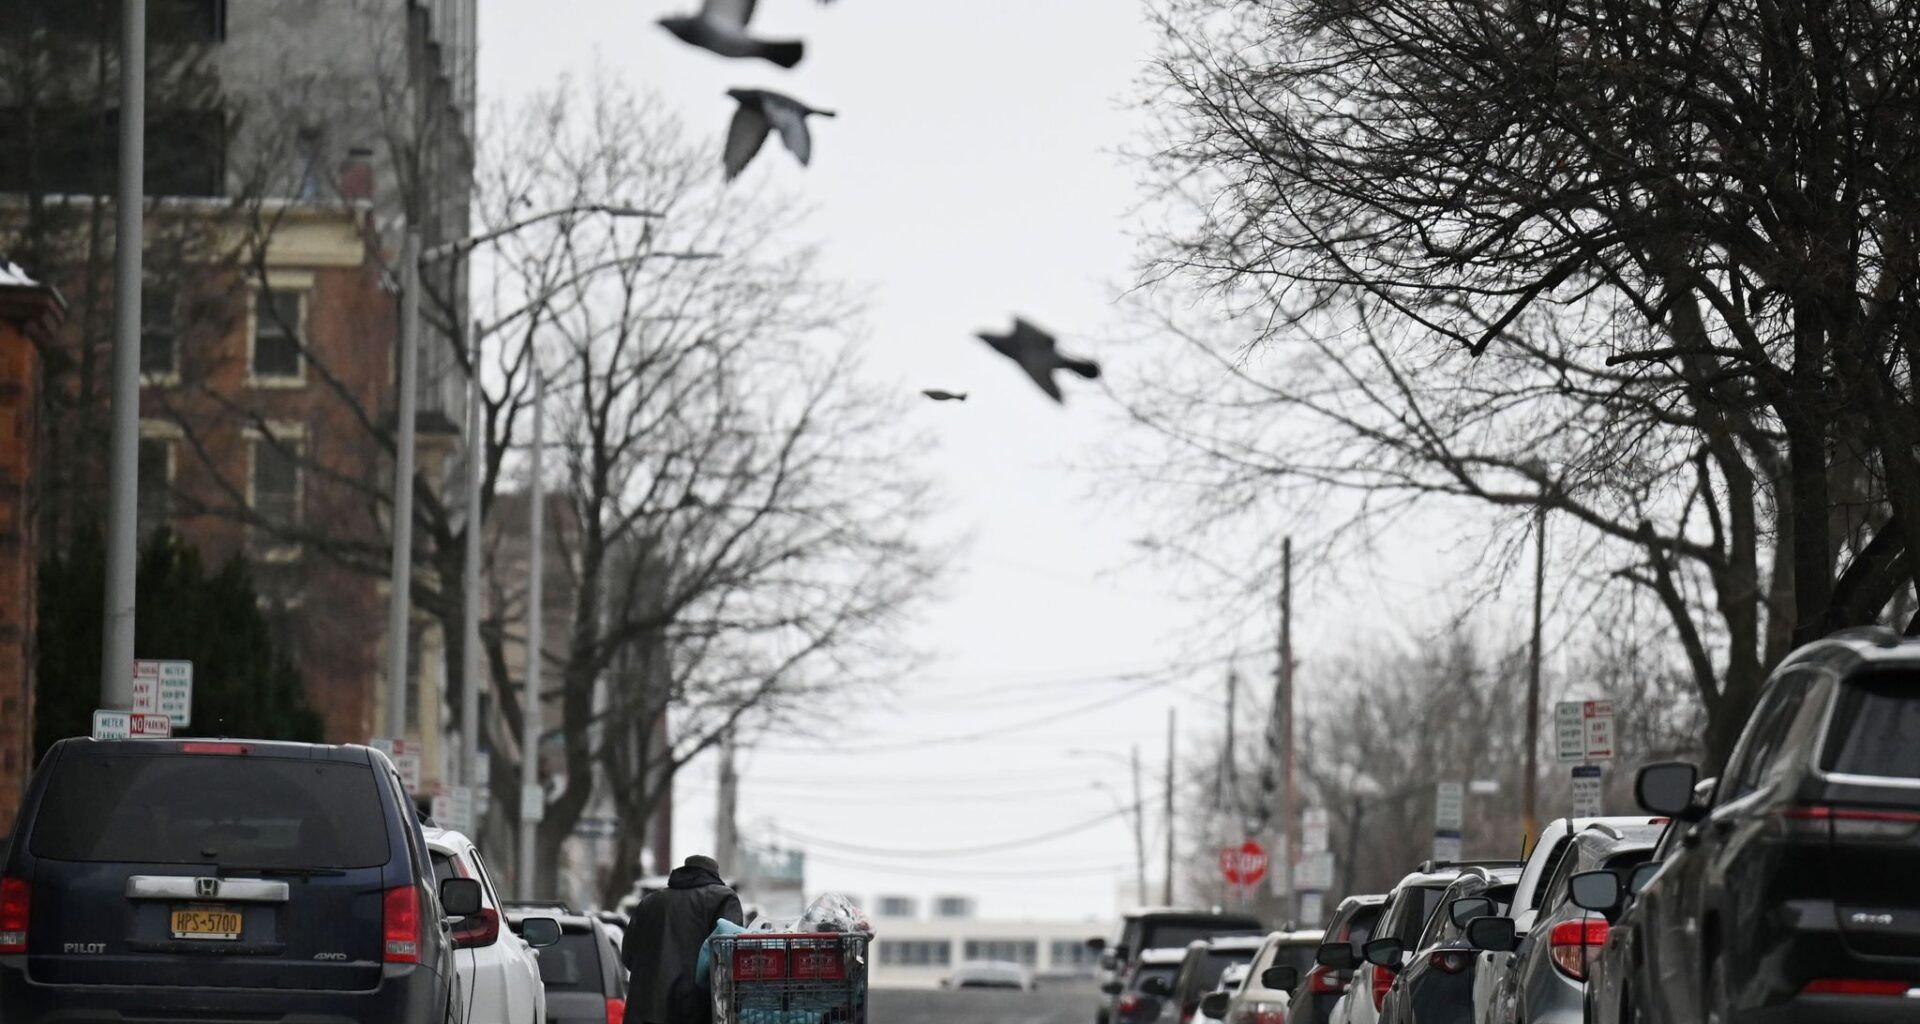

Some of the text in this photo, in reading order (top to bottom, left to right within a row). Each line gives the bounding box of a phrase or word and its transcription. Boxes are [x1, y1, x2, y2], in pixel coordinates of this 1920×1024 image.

[101, 718, 124, 727] METER
[131, 717, 167, 731] NO PARKING
[64, 943, 107, 954] PILOT
[313, 952, 347, 960] 4WD
